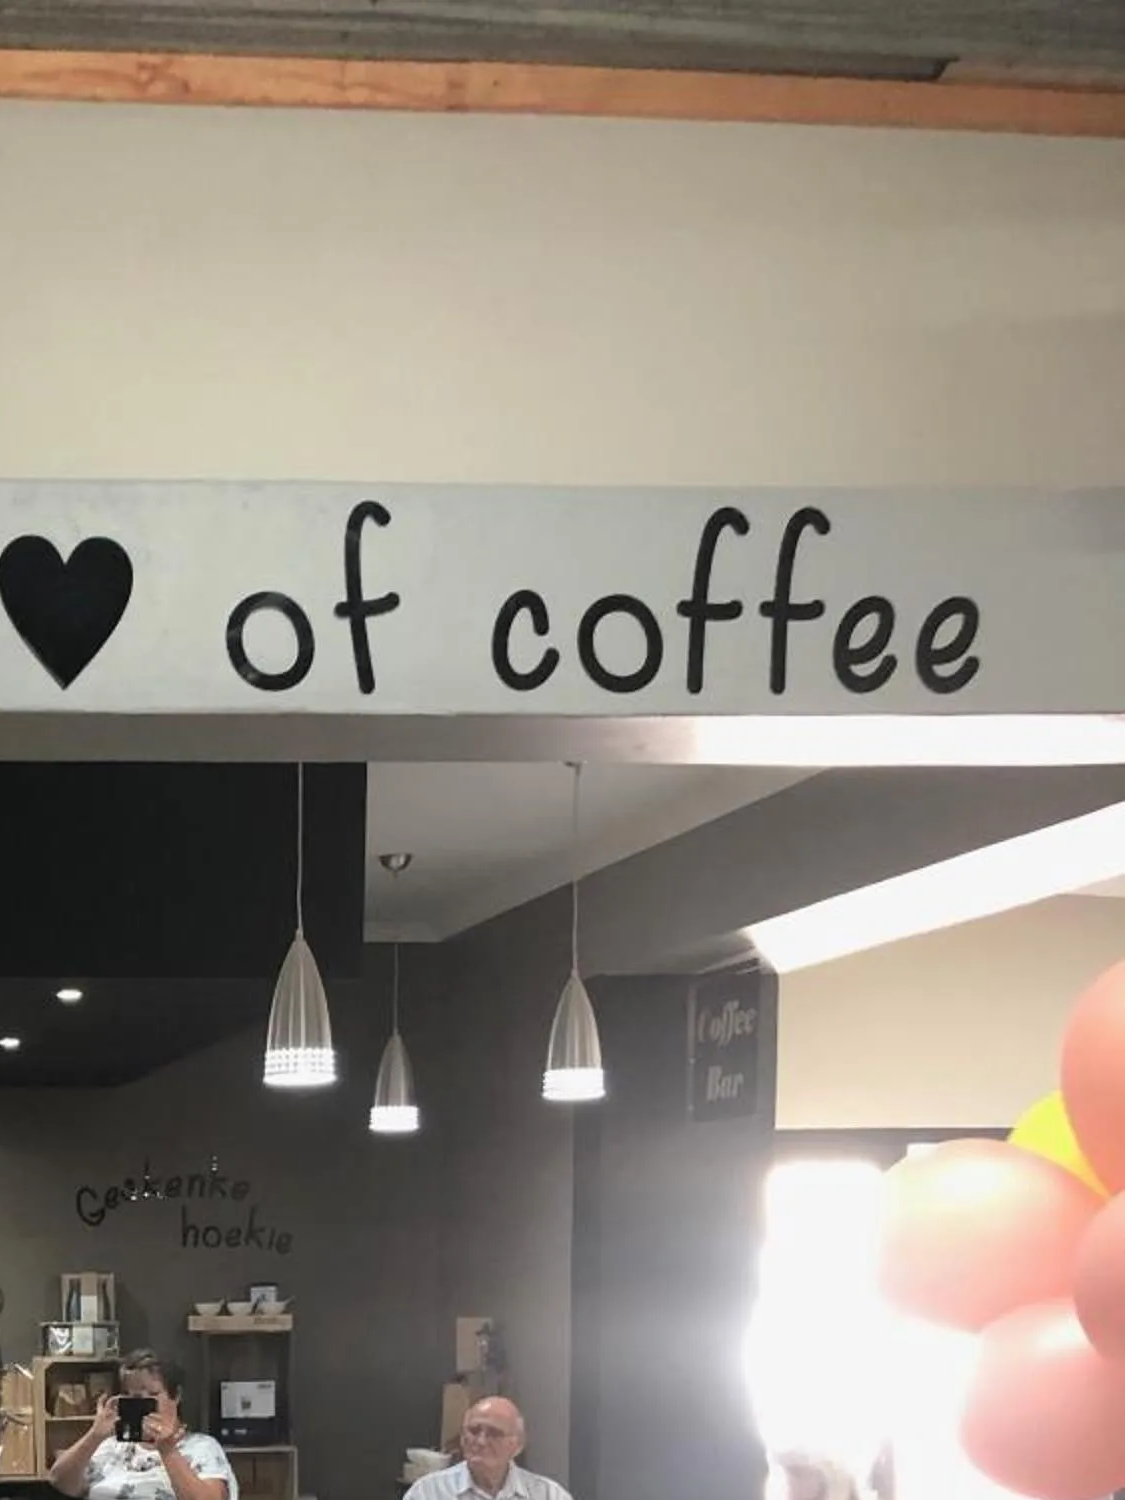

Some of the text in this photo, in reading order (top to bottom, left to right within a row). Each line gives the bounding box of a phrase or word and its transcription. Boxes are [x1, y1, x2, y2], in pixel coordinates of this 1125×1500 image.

[225, 500, 400, 694] of
[491, 506, 980, 695] coffee
[698, 1000, 757, 1047] Coffee
[707, 1066, 744, 1101] Bar
[180, 1205, 294, 1254] hoekie
